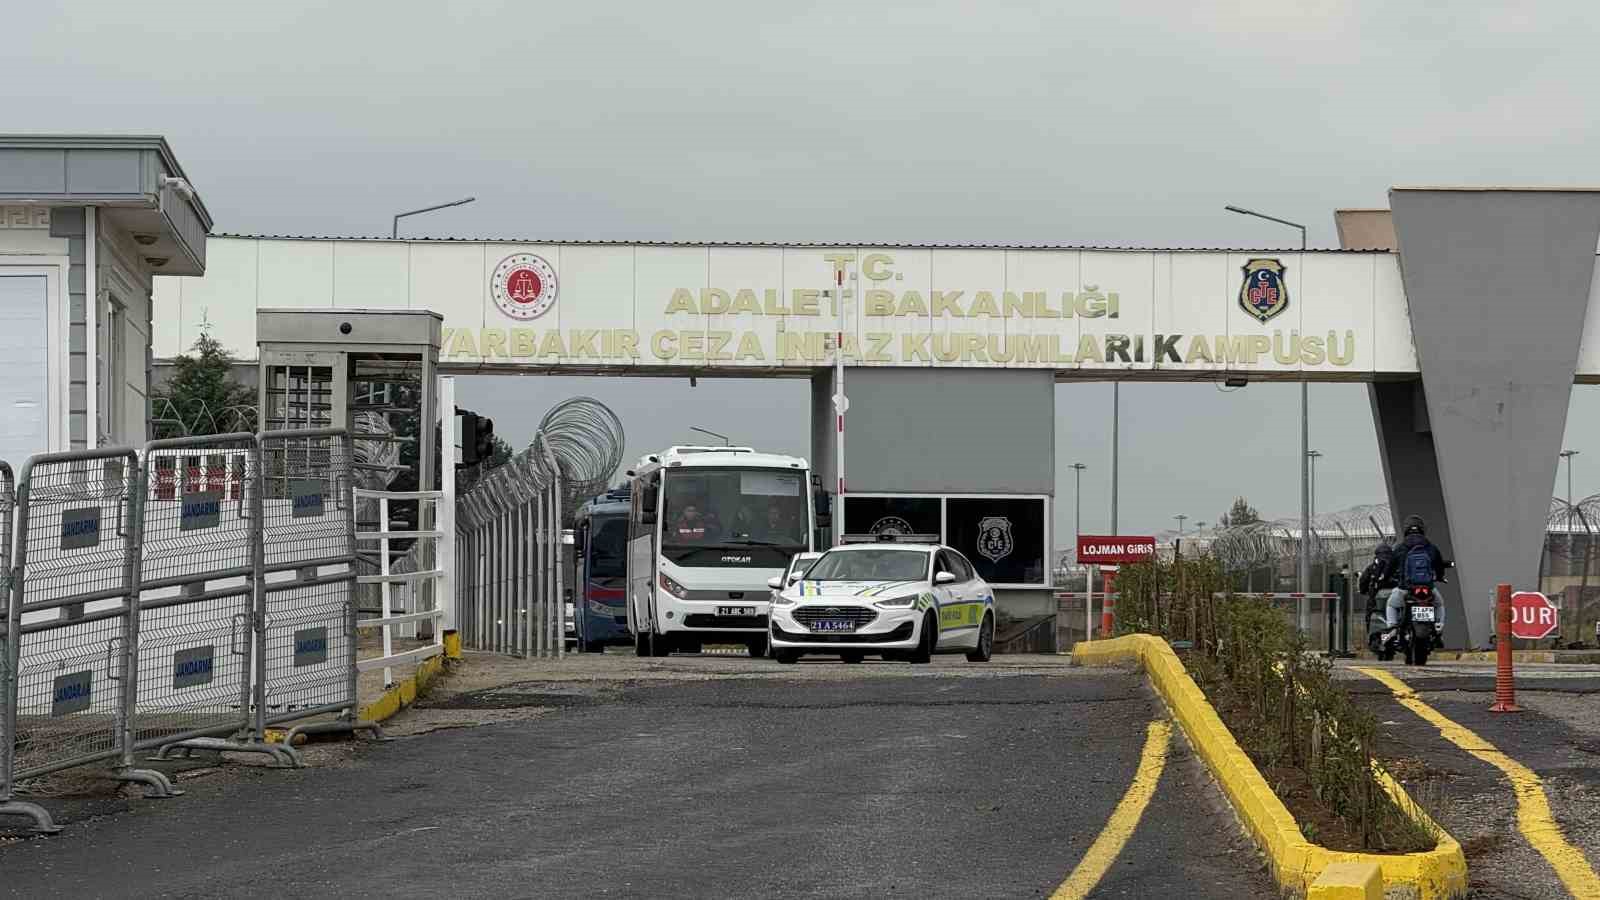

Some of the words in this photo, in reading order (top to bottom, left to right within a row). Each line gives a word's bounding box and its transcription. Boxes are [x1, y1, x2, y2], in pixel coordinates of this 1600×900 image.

[824, 253, 903, 281] T.C.
[664, 287, 853, 317] ADALET
[864, 284, 1120, 319] BAKANLIĞI
[650, 329, 765, 361] CEZA
[776, 320, 893, 362] İNFAZ
[902, 332, 1144, 363] KURUMLARI
[1154, 329, 1354, 366] KAMPÜSÜ
[182, 502, 219, 518] JANDARMA
[63, 519, 98, 536] JANDARMA
[1083, 545, 1124, 555] LOJMAN
[175, 658, 212, 678] JANDARMA
